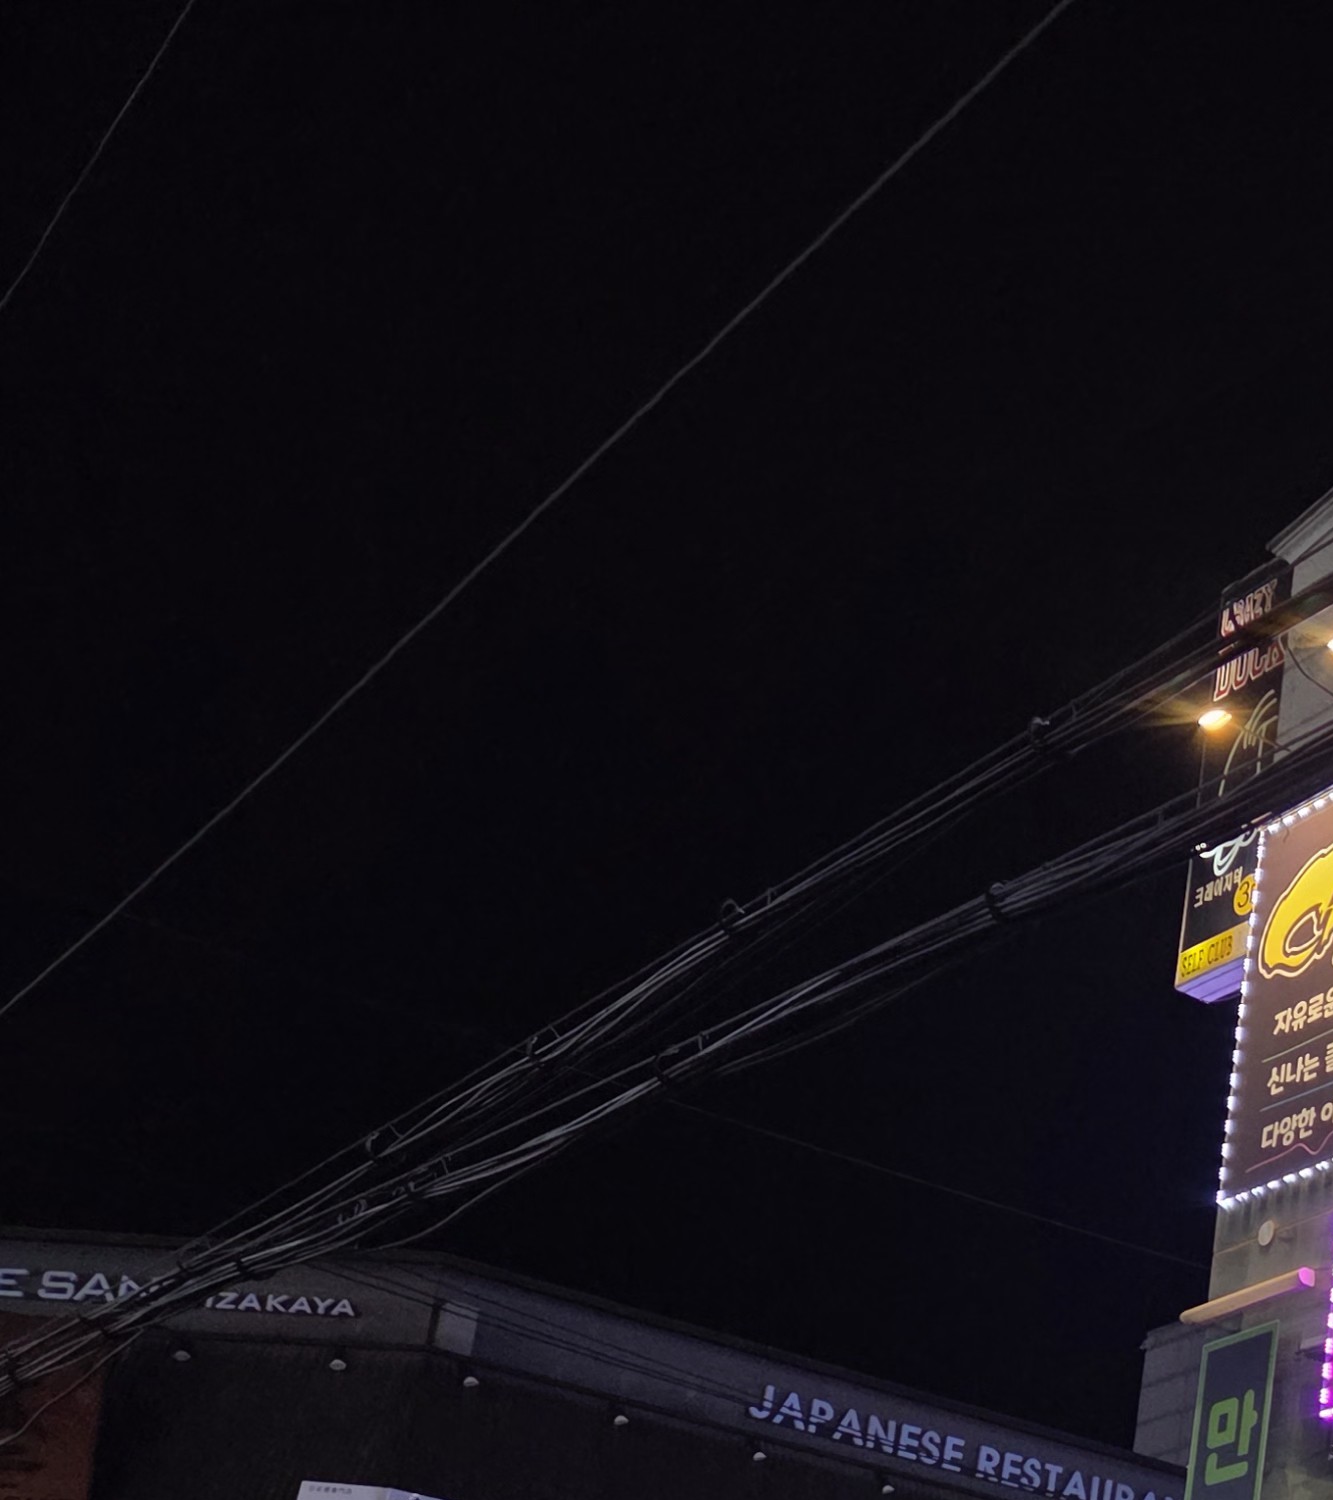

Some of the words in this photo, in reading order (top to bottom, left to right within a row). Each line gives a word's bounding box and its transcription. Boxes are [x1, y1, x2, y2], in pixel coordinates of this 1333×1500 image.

[1181, 949, 1204, 977] SELF
[1266, 1052, 1320, 1096] 신나는
[1261, 1106, 1316, 1149] 다양한
[205, 1290, 356, 1318] IZAKAYA
[749, 1385, 965, 1472] JAPANESE
